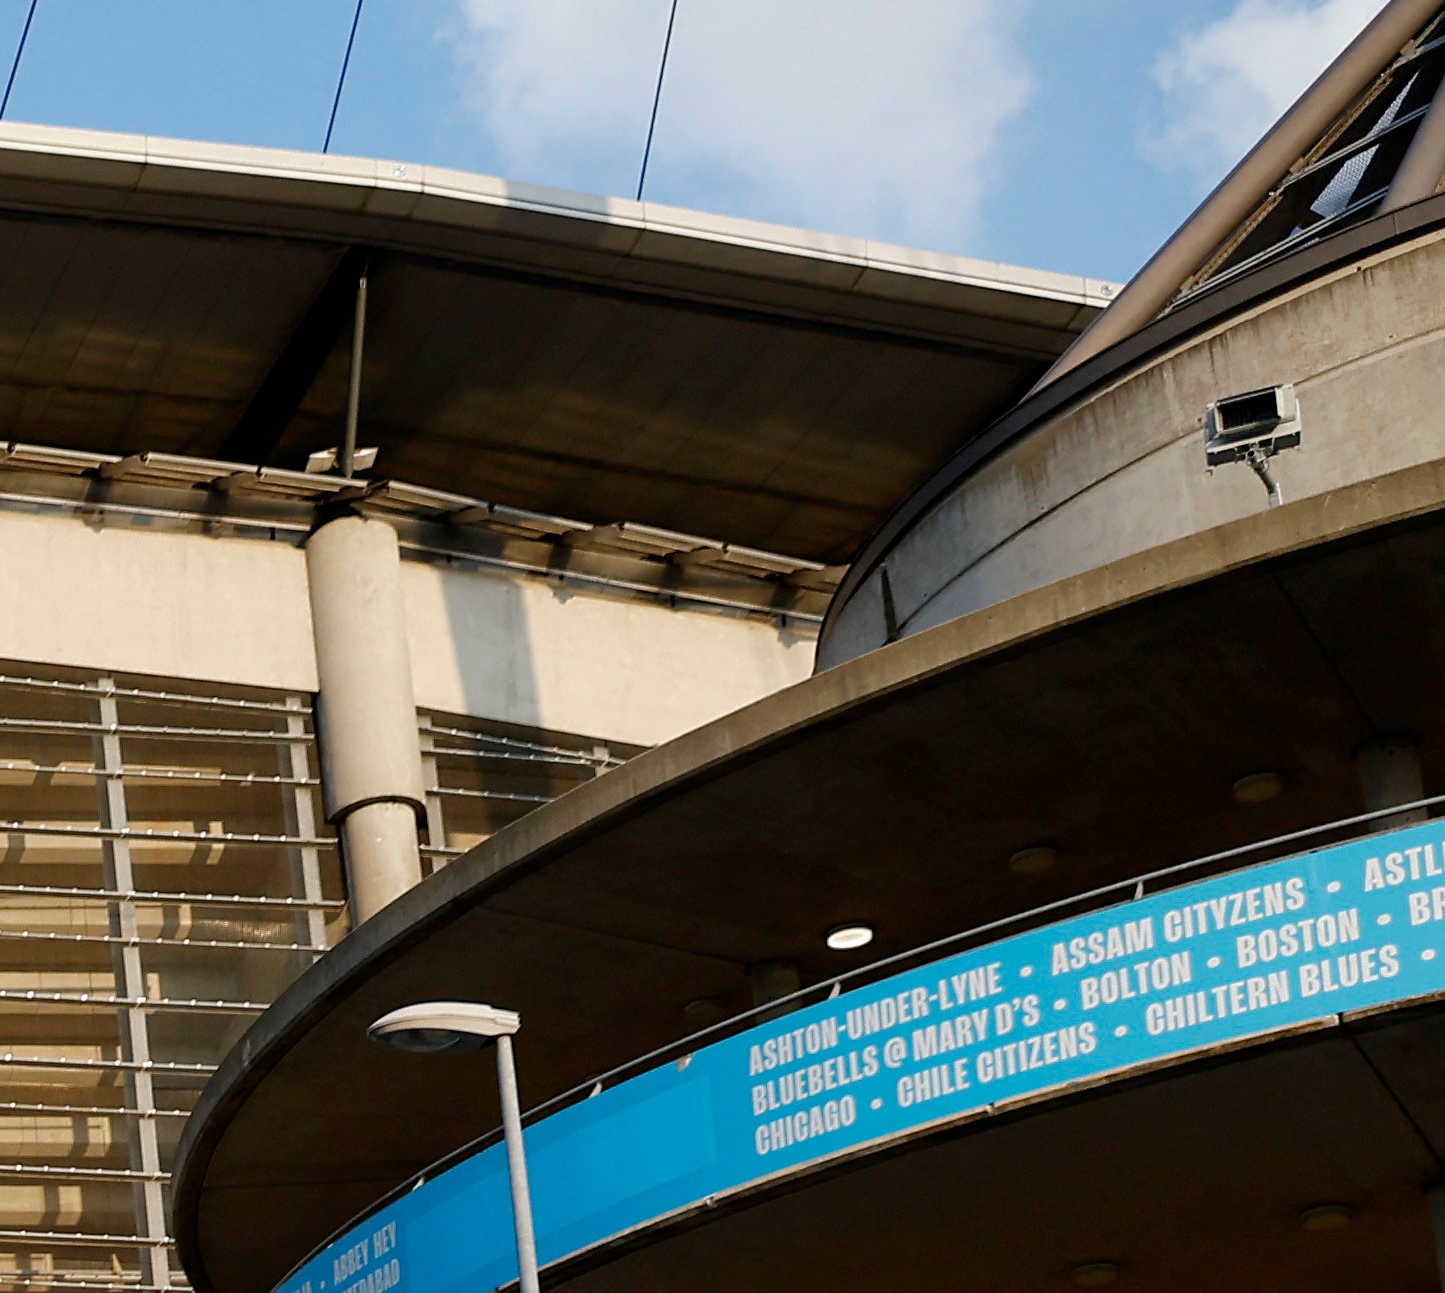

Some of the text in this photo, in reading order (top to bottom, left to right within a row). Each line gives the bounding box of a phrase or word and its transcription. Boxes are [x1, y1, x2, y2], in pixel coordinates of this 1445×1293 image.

[749, 877, 1306, 1076] ASHTON-UNDER-LYNE ASSAM CITYZENS
[752, 908, 1360, 1115] BLUEBELLS MARY D'S BOLTON BOSTON
[754, 945, 1399, 1155] CHICAGO CHILE CITIZENS CHILTERN BLUES
[373, 1221, 396, 1259] HEY
